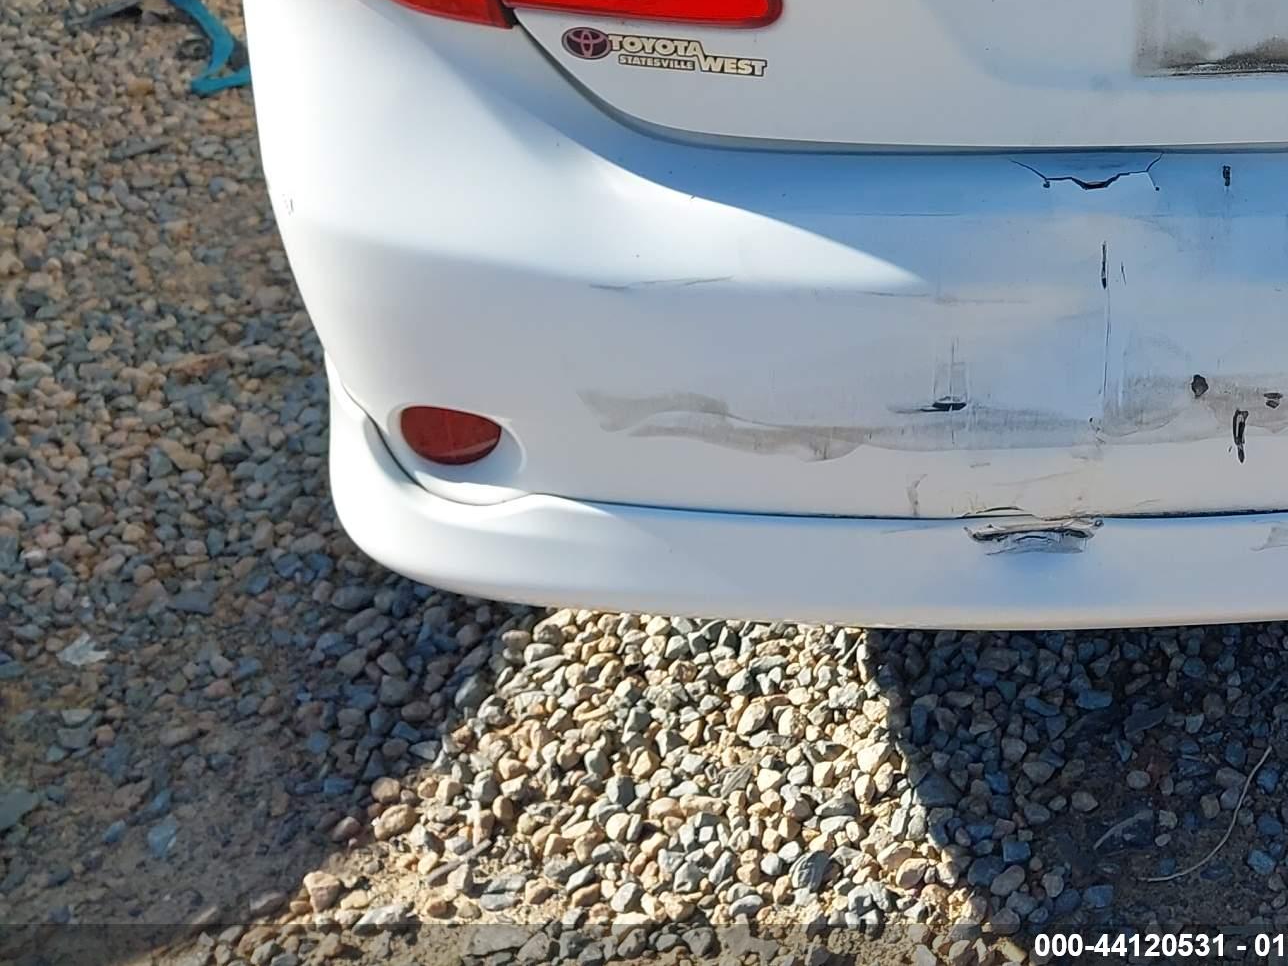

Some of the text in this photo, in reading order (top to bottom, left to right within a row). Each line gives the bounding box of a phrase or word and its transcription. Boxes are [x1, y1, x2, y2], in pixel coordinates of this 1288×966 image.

[609, 35, 766, 75] TOYOTA WEST
[619, 56, 694, 69] STATESVILLE
